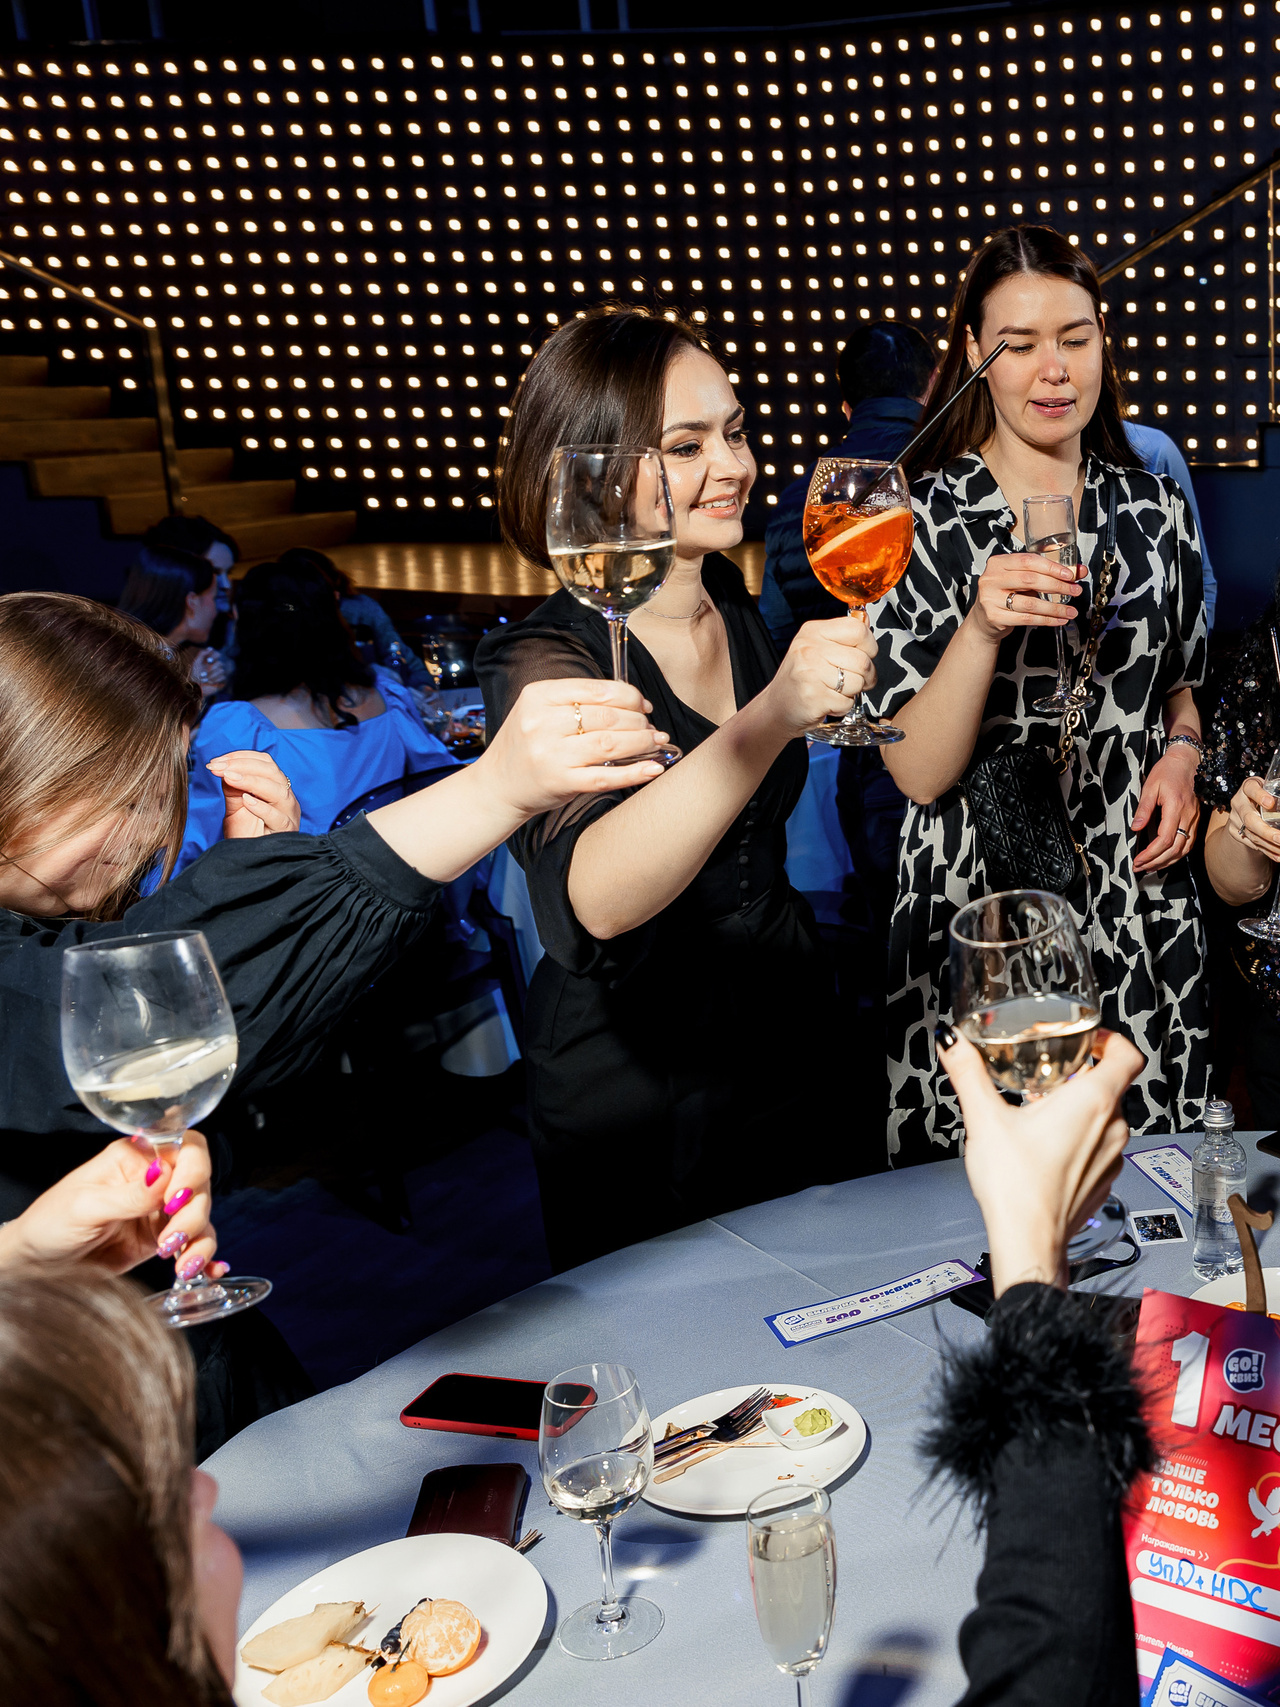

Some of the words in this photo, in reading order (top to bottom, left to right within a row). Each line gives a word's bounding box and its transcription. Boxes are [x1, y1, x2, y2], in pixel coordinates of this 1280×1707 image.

[859, 1278, 922, 1303] GO!КВИЗ
[826, 1309, 861, 1324] 500
[1227, 1353, 1259, 1373] GO!
[1171, 1330, 1210, 1428] 1
[1229, 1373, 1259, 1383] КВИЗ
[1151, 1477, 1220, 1509] ТОЛЬКО
[1145, 1496, 1220, 1530] ЛЮБОВЬ
[1141, 1533, 1196, 1557] Награждается
